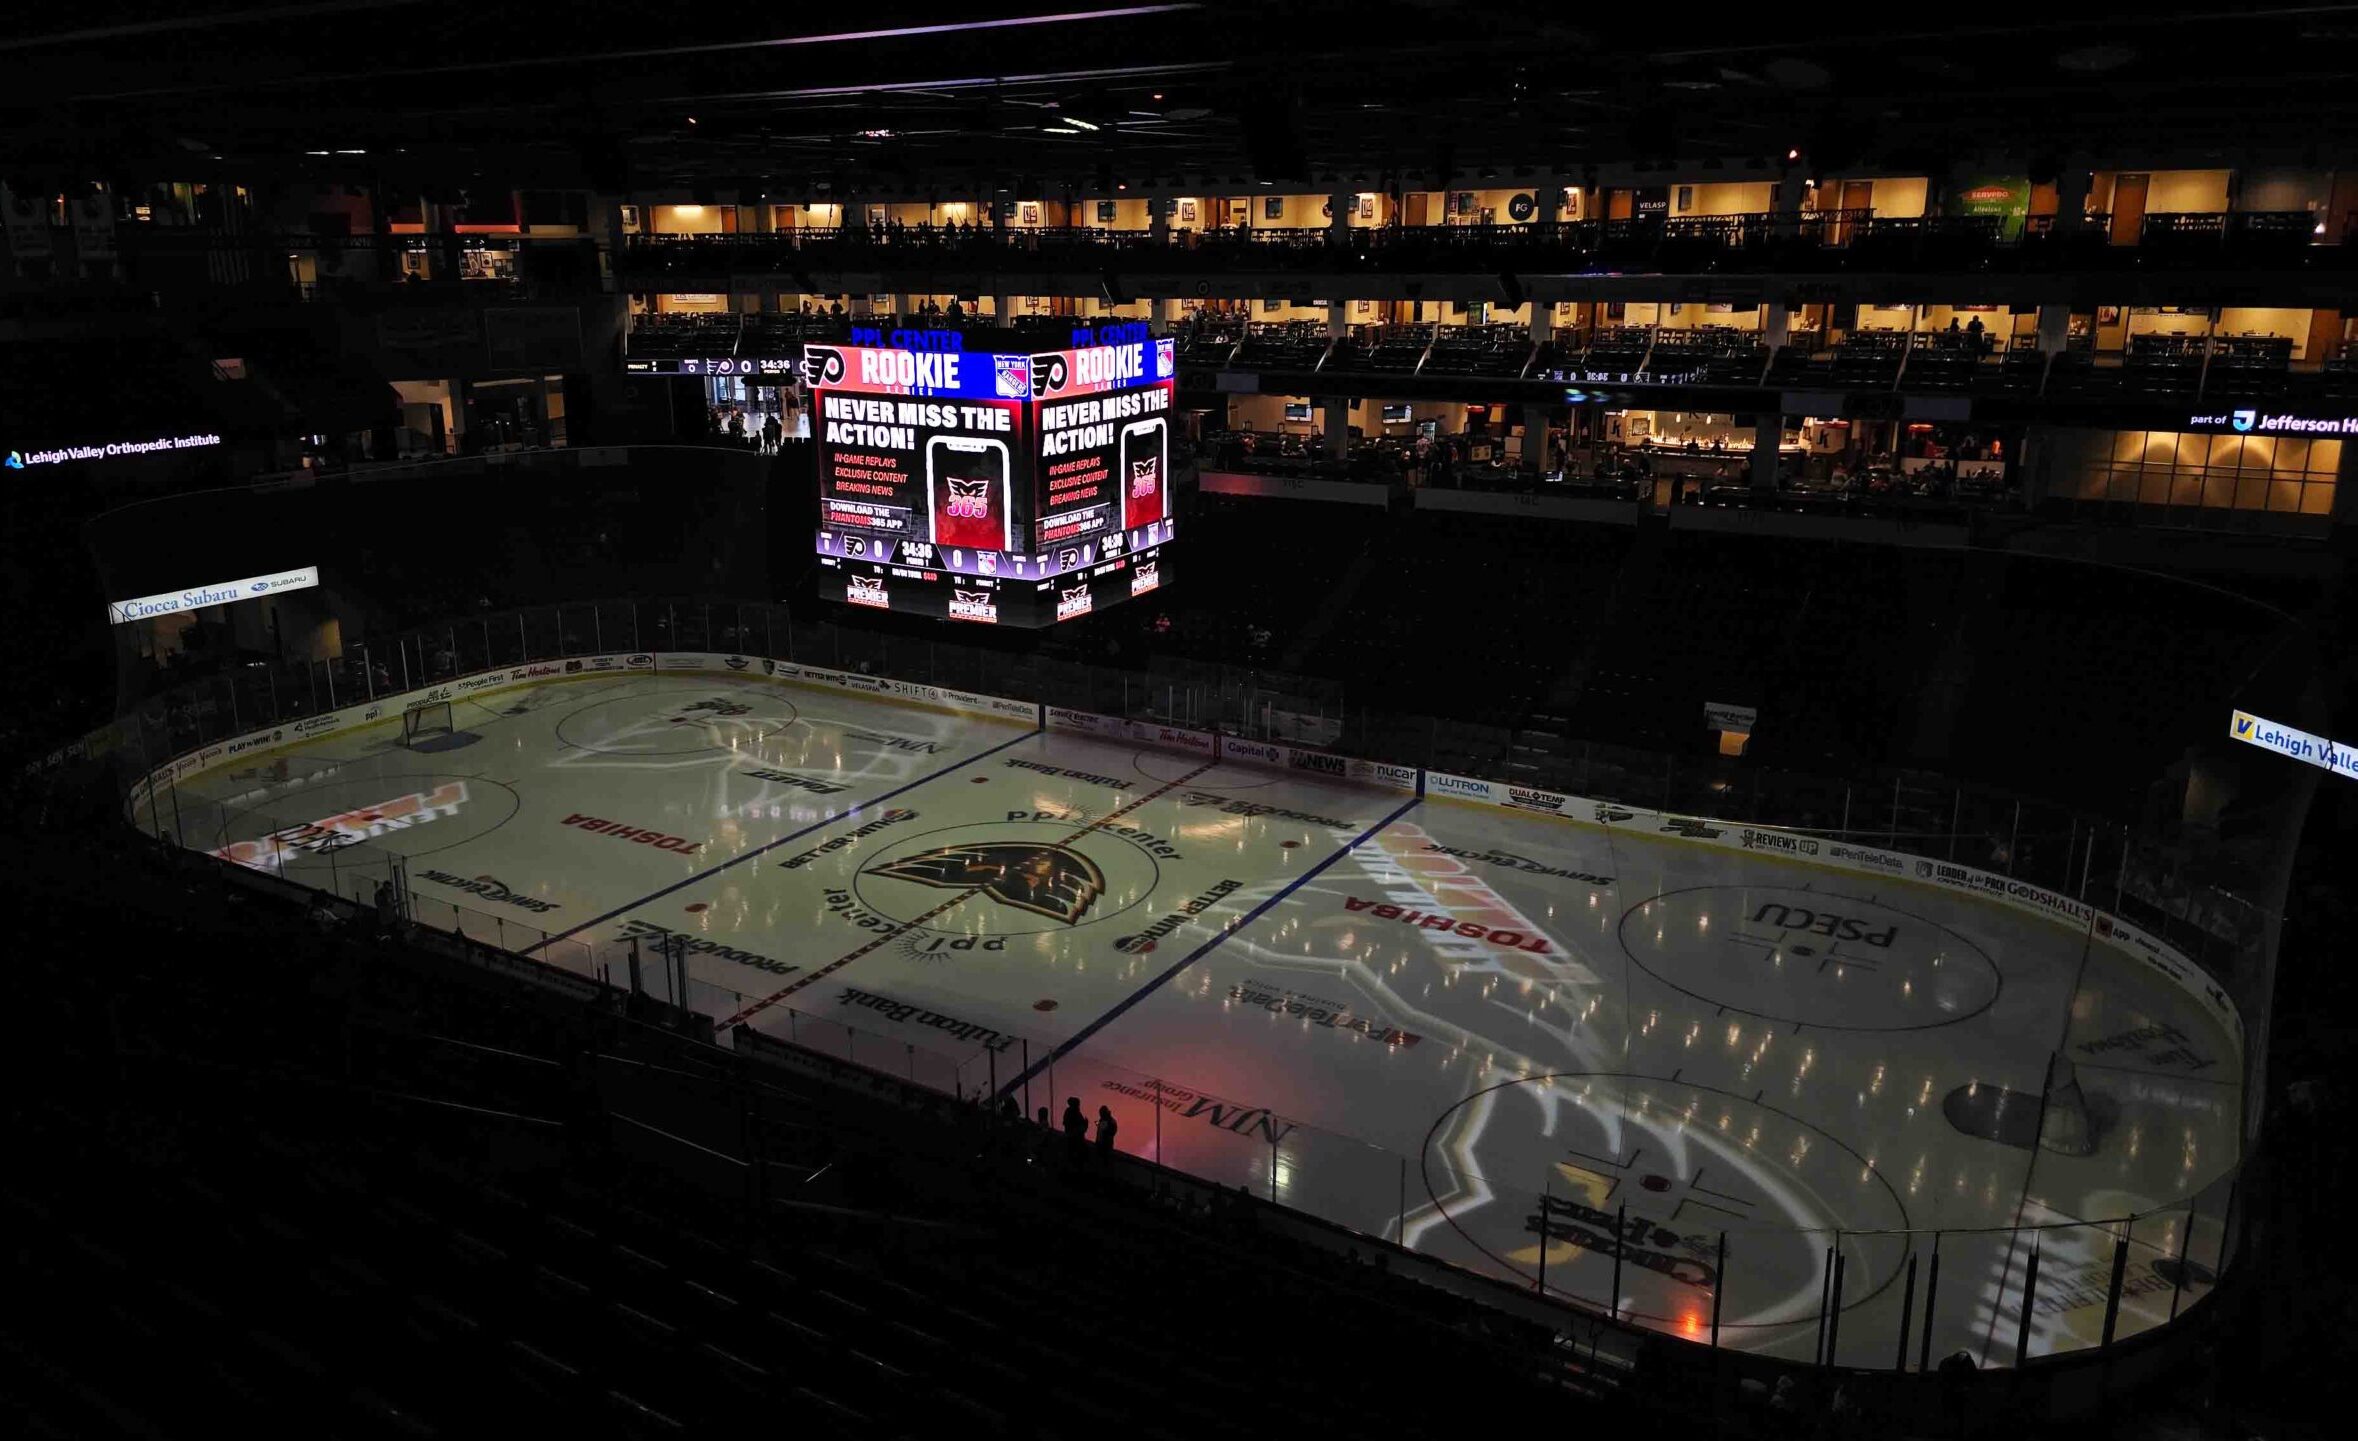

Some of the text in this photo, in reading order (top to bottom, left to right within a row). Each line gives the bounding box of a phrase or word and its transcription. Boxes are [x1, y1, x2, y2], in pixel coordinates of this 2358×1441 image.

[852, 328, 963, 351] PPL CENTER
[741, 360, 751, 372] 0
[760, 359, 790, 369] 34:36
[861, 350, 961, 389] ROOKIE
[1076, 343, 1143, 386] ROOKIE
[825, 398, 1011, 432] NEVER MISS THE
[1043, 388, 1168, 430] NEVER MISS THE
[2190, 415, 2213, 424] part
[2214, 415, 2227, 424] of
[2258, 415, 2339, 432] Jefferson
[826, 422, 915, 450] ACTION!
[1042, 426, 1114, 456] ACTION!
[25, 433, 220, 465] Lehigh Valley Orthopedic Institute
[834, 453, 897, 468] IN-GAME REPLAYS
[1077, 457, 1101, 471] REPLAYS
[835, 468, 908, 483] EXCLUSIVE CONTENT
[1050, 470, 1108, 491] EXCLUSIVE CONTENT
[836, 482, 893, 496] BREAKING NEWS
[1050, 486, 1098, 505] BREAKING NEWS
[1132, 474, 1155, 499] 365
[830, 502, 890, 517] DOWNLOAD THE
[947, 495, 987, 518] 365
[886, 517, 903, 529] APP
[1044, 509, 1094, 529] DOWNLOAD THE
[1090, 517, 1104, 530] APP
[874, 540, 882, 557] 0
[902, 541, 932, 558] 34:36
[953, 550, 962, 567] 0
[270, 576, 307, 588] SUBARU
[124, 587, 238, 618] Ciocca Subaru
[847, 586, 889, 603] PREMIER
[949, 601, 997, 618] PREMIER
[1057, 595, 1092, 616] PREMIER
[465, 677, 488, 688] People
[510, 669, 526, 681] Tim
[894, 683, 926, 697] SHIFT
[366, 709, 378, 721] ppl
[1159, 728, 1175, 741] Tim
[2255, 725, 2313, 756] Lehigh
[229, 743, 245, 754] PLAY
[1228, 742, 1264, 757] Capital
[1307, 753, 1346, 773] NEWS
[1377, 765, 1416, 780] nucar
[1005, 758, 1138, 790] Fulton Bank
[1439, 777, 1489, 793] LUTRON
[1509, 788, 1531, 797] DUAL
[1541, 794, 1565, 804] TEMP
[1007, 809, 1070, 823] ppl
[1235, 801, 1356, 830] PRODUCTS
[560, 812, 703, 855] TOSHIBA
[1104, 822, 1185, 860] center
[1756, 833, 1797, 850] REVIEWS
[779, 836, 851, 869] BETTER
[1840, 848, 1904, 869] PenTeleData
[1937, 865, 1967, 881] LEADER
[2007, 881, 2092, 921] GODSHALL'S
[824, 888, 894, 935] center
[1149, 879, 1244, 943] BETTER WITH
[1344, 896, 1555, 955] TOSHIBA
[1754, 903, 1899, 948] PSECU
[928, 935, 1009, 952] ppl
[837, 987, 1017, 1053] Fulton Bank
[1101, 1080, 1181, 1115] Insurance
[1144, 1079, 1195, 1101] Group
[1180, 1097, 1299, 1144] NJM
